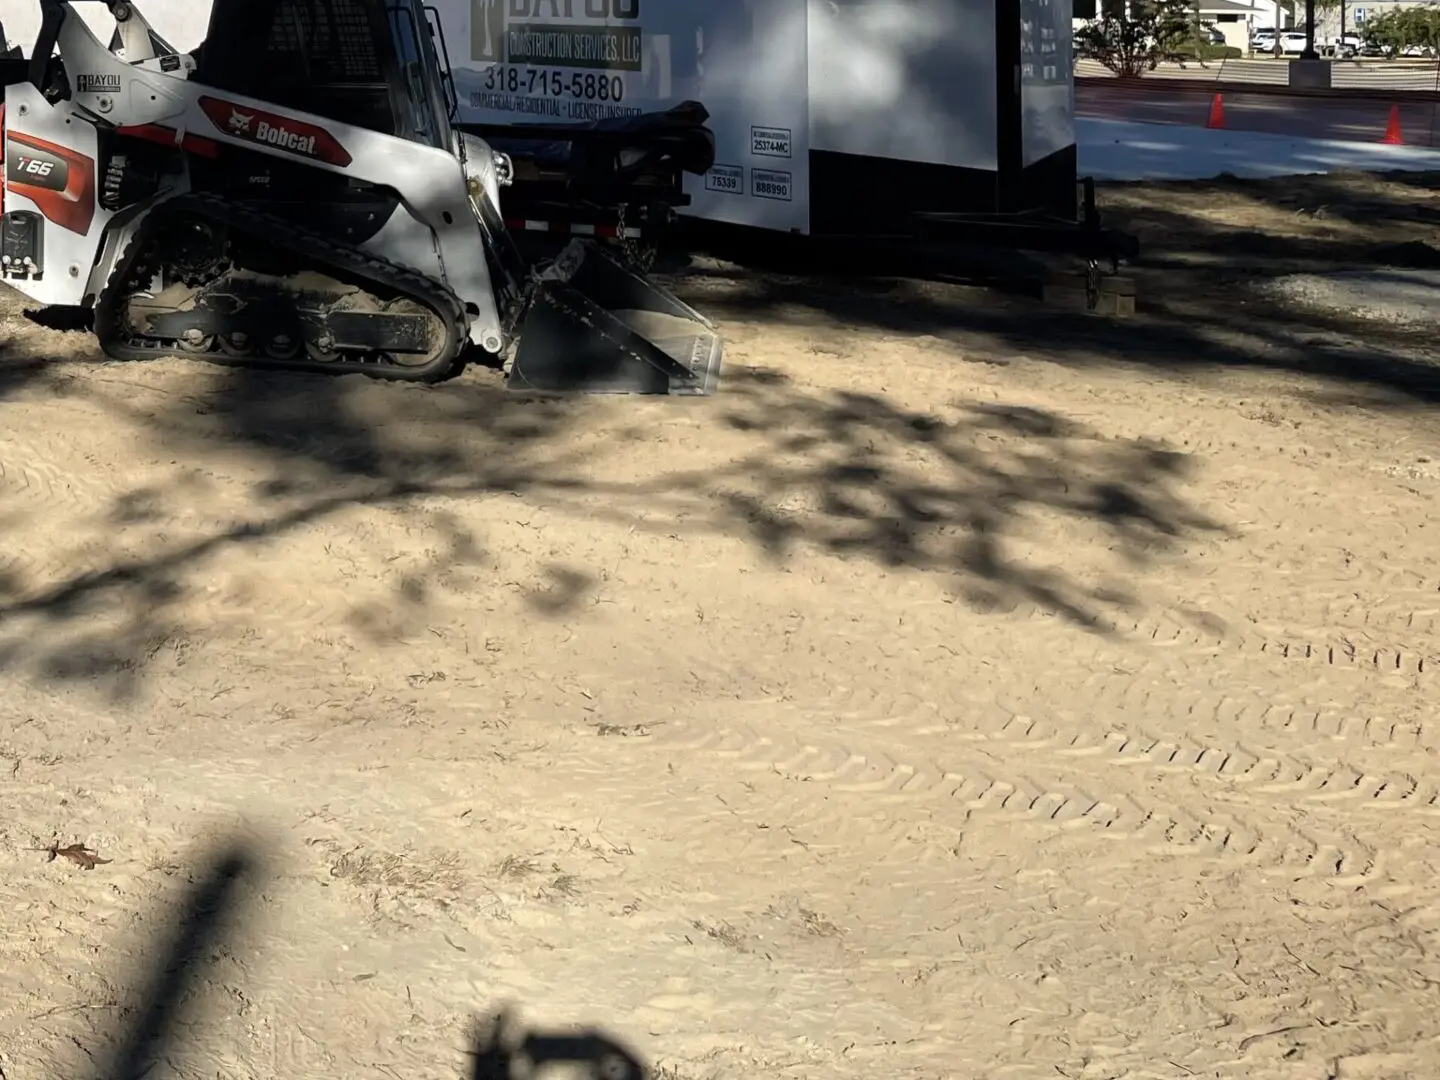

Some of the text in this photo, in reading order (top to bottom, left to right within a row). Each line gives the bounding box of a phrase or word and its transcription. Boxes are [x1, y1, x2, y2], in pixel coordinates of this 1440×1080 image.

[510, 31, 640, 63] CONSTRUCTION SERVICES, LLC
[88, 74, 120, 86] BAYOU
[485, 68, 623, 102] 318-715-5880
[256, 120, 316, 155] Bobcat
[754, 139, 788, 153] 25374-MC
[17, 156, 54, 176] T66
